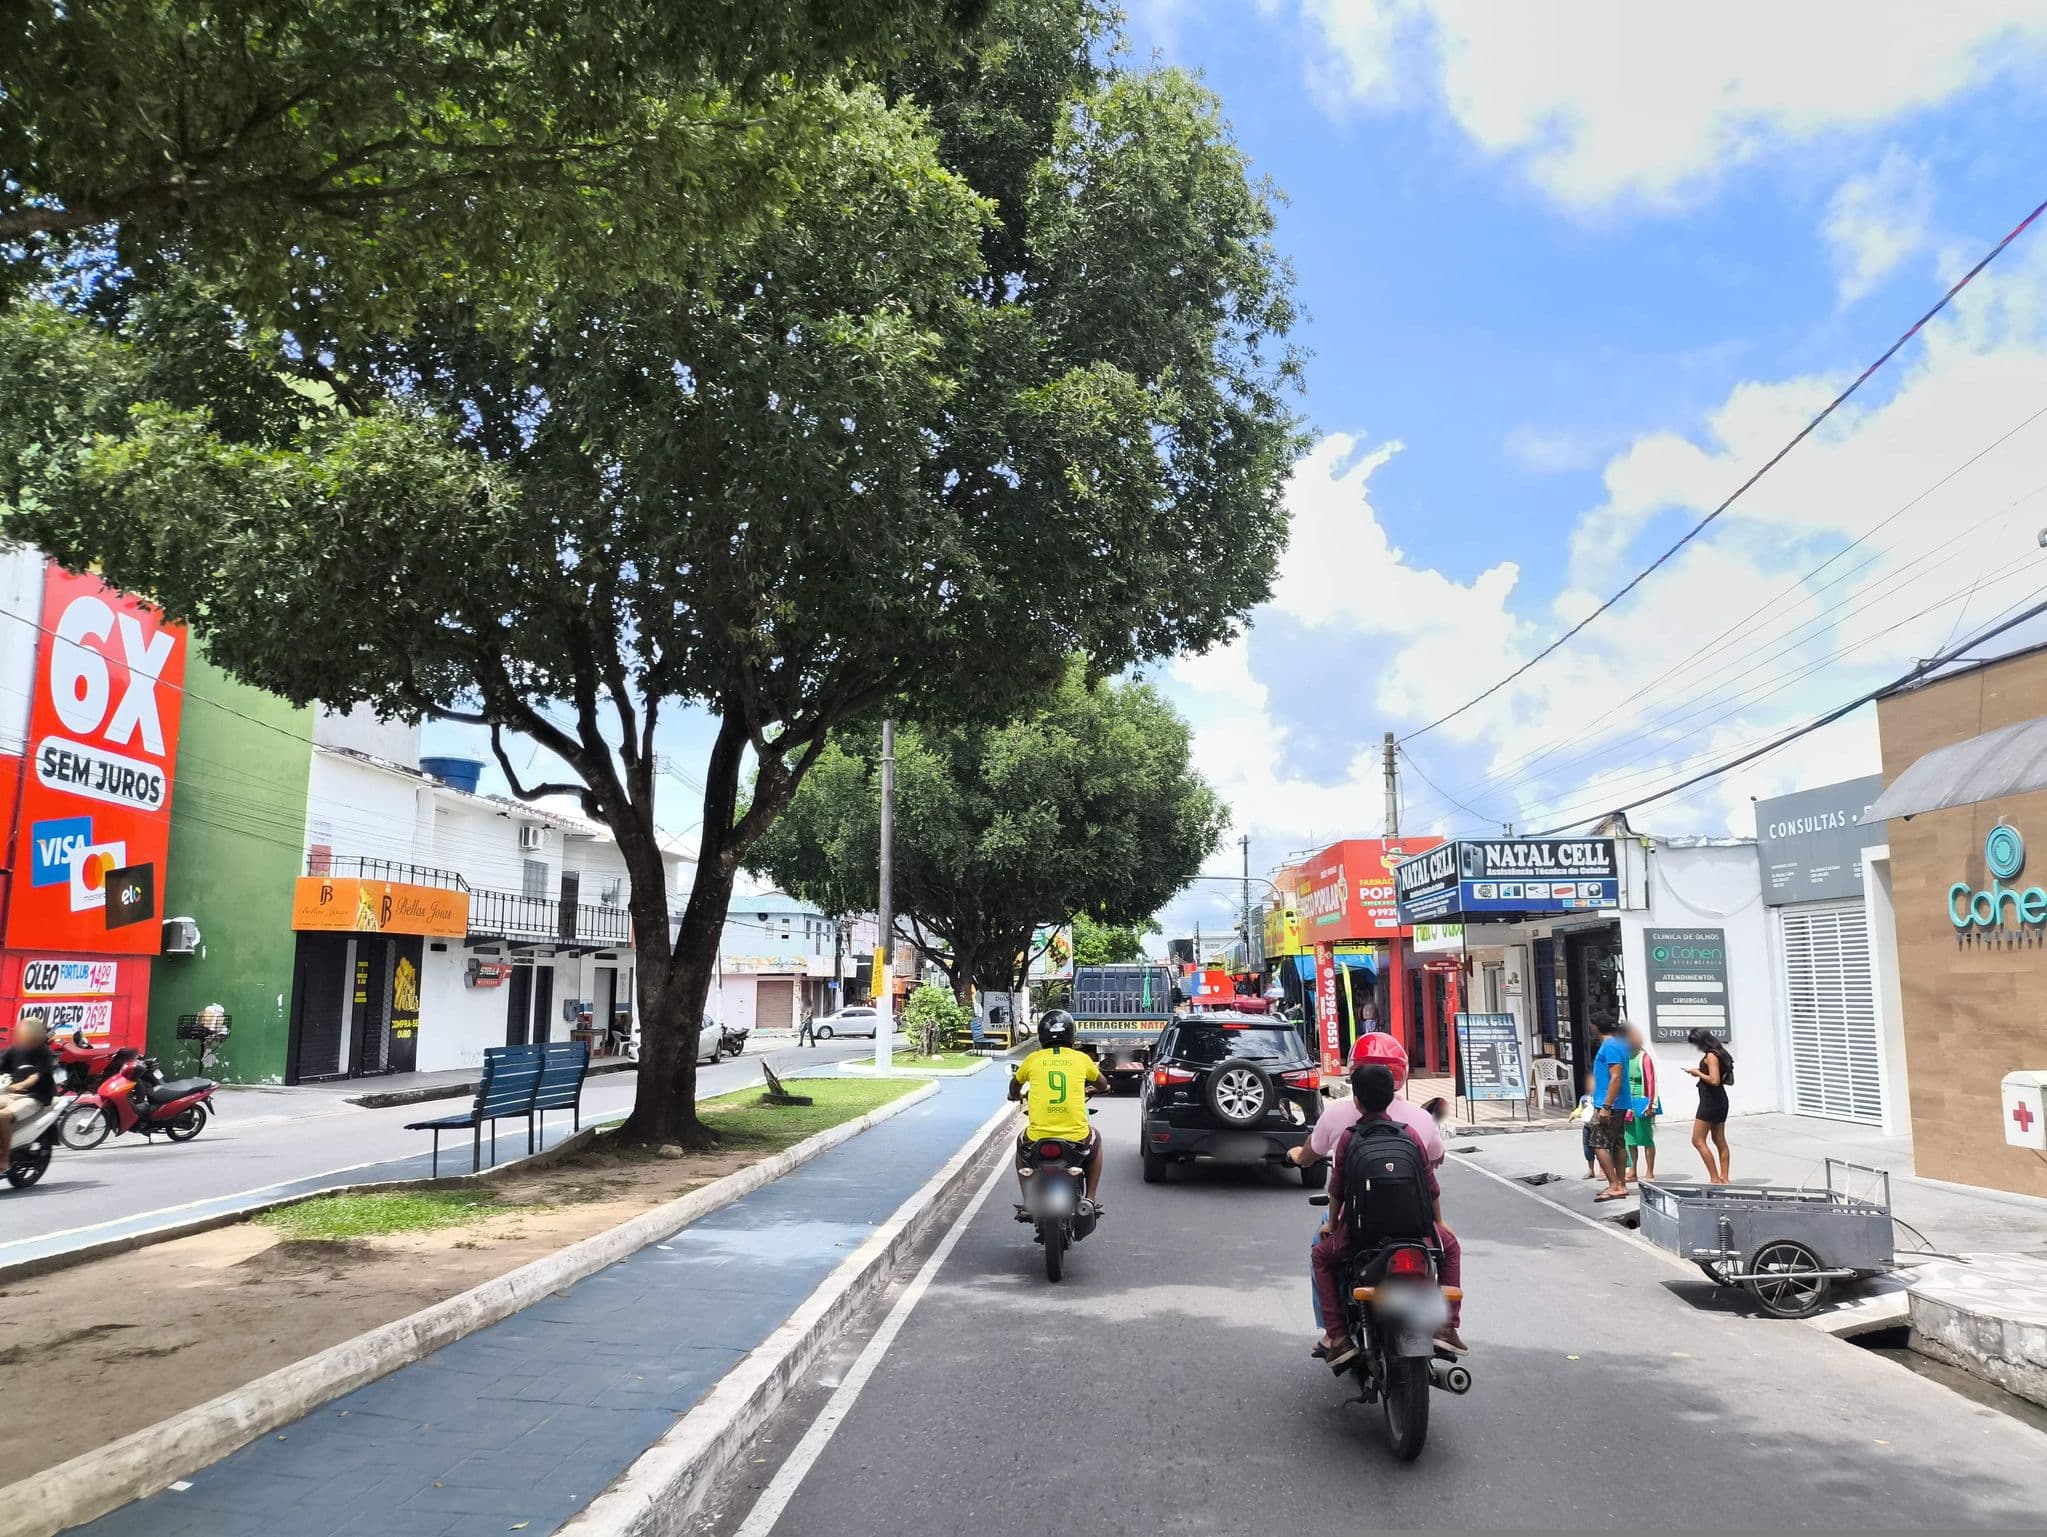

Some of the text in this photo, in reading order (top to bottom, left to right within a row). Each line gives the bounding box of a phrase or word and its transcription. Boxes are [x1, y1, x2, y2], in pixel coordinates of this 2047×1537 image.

[51, 596, 176, 757] 6X
[42, 747, 161, 803] SEM JUROS
[1769, 810, 1845, 839] CONSULTAS
[1401, 858, 1430, 891] NATAL
[1430, 847, 1456, 880] CELL
[1485, 843, 1610, 867] NATAL CELL
[121, 885, 142, 905] elo
[1360, 887, 1396, 900] POP
[1671, 945, 1722, 960] Cohen
[24, 962, 59, 991] ÓLEO
[1078, 1021, 1137, 1030] FERRAGENS
[1324, 979, 1338, 1049] 99398-0551
[1048, 1071, 1066, 1104] 9
